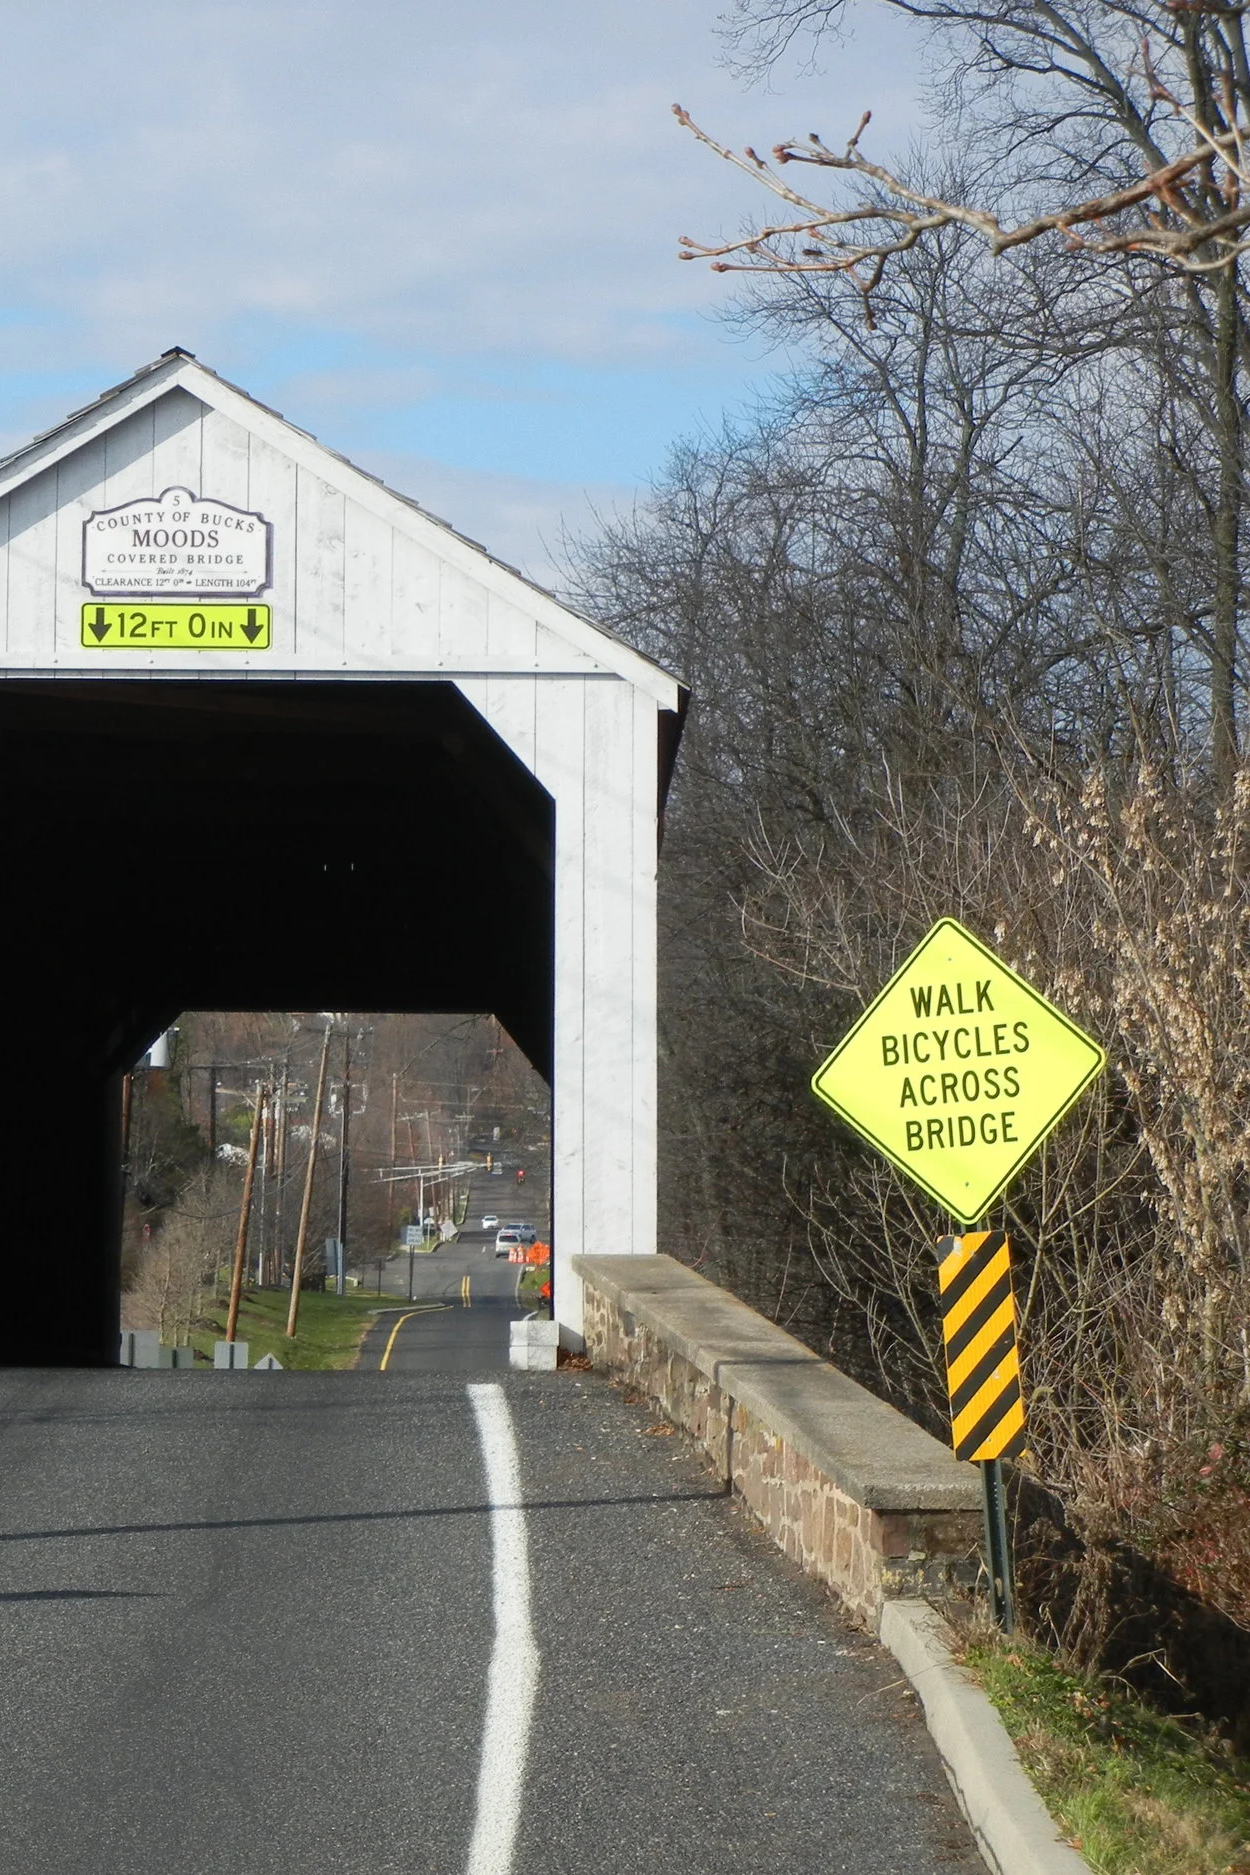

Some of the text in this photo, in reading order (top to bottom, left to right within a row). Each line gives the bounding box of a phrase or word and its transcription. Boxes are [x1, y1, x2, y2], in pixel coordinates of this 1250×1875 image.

[172, 496, 180, 505] 5
[96, 512, 255, 533] COUNTY OF BUCKS
[132, 530, 219, 547] MOODS
[107, 554, 244, 564] COVERED BRIDGE
[195, 579, 233, 587] LENGTH
[118, 612, 233, 638] 12FT 0IN
[910, 980, 994, 1018] WALK
[882, 1022, 1029, 1066] BICYCLES
[900, 1066, 1020, 1108] ACROSS
[906, 1112, 1018, 1151] BRIDGE
